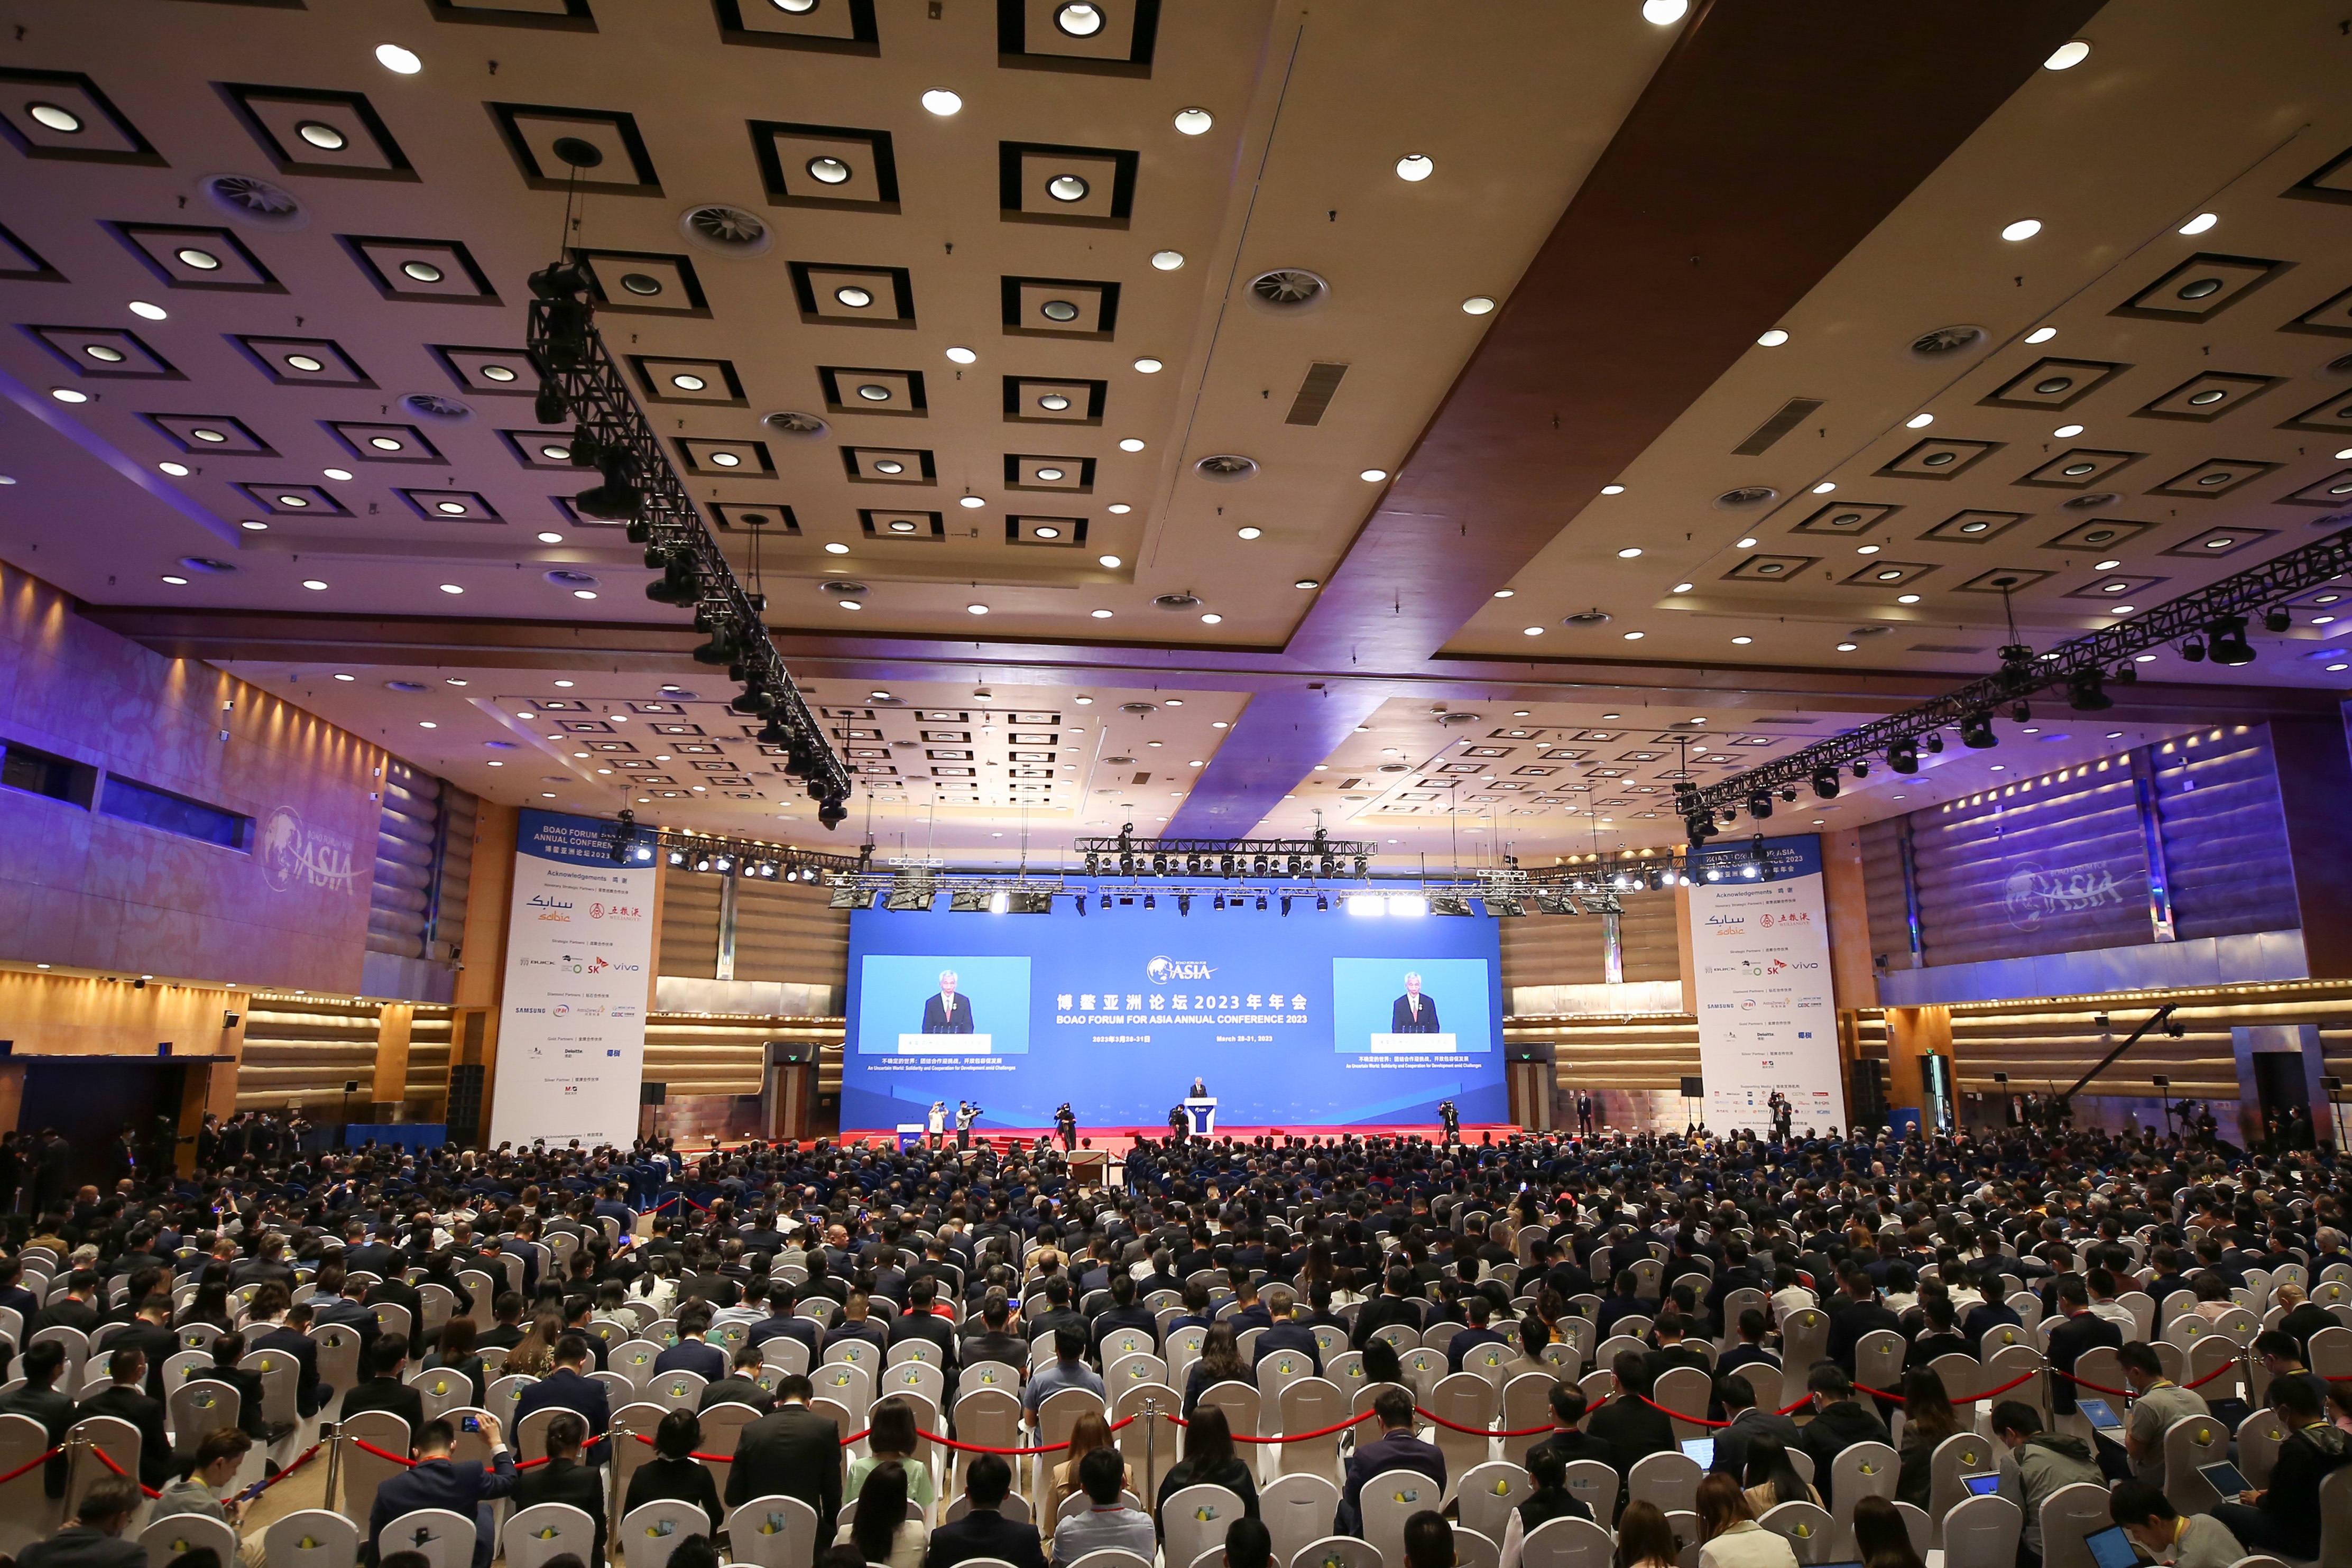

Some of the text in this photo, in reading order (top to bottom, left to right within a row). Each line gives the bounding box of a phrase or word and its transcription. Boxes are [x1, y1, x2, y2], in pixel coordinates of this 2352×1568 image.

[543, 826, 567, 835] BOAO
[569, 829, 598, 838] FORUM
[534, 833, 568, 844] ANNUAL
[570, 838, 613, 849] CONFEREN
[297, 842, 353, 896] ASIA
[547, 870, 607, 882] Acknowledgements
[1716, 890, 1772, 898] Acknowledgements
[2049, 870, 2124, 914] ASIA
[527, 895, 573, 910] سابك
[538, 910, 571, 922] sabic
[1705, 915, 1744, 927] سابك
[1717, 926, 1745, 936] sabic
[588, 965, 599, 974] SK
[613, 963, 639, 971] vivo
[1172, 964, 1211, 979] ASIA
[1056, 1015, 1307, 1024] BOAO FORUM FOR ASIA ANNUAL CONFERENCE 2023
